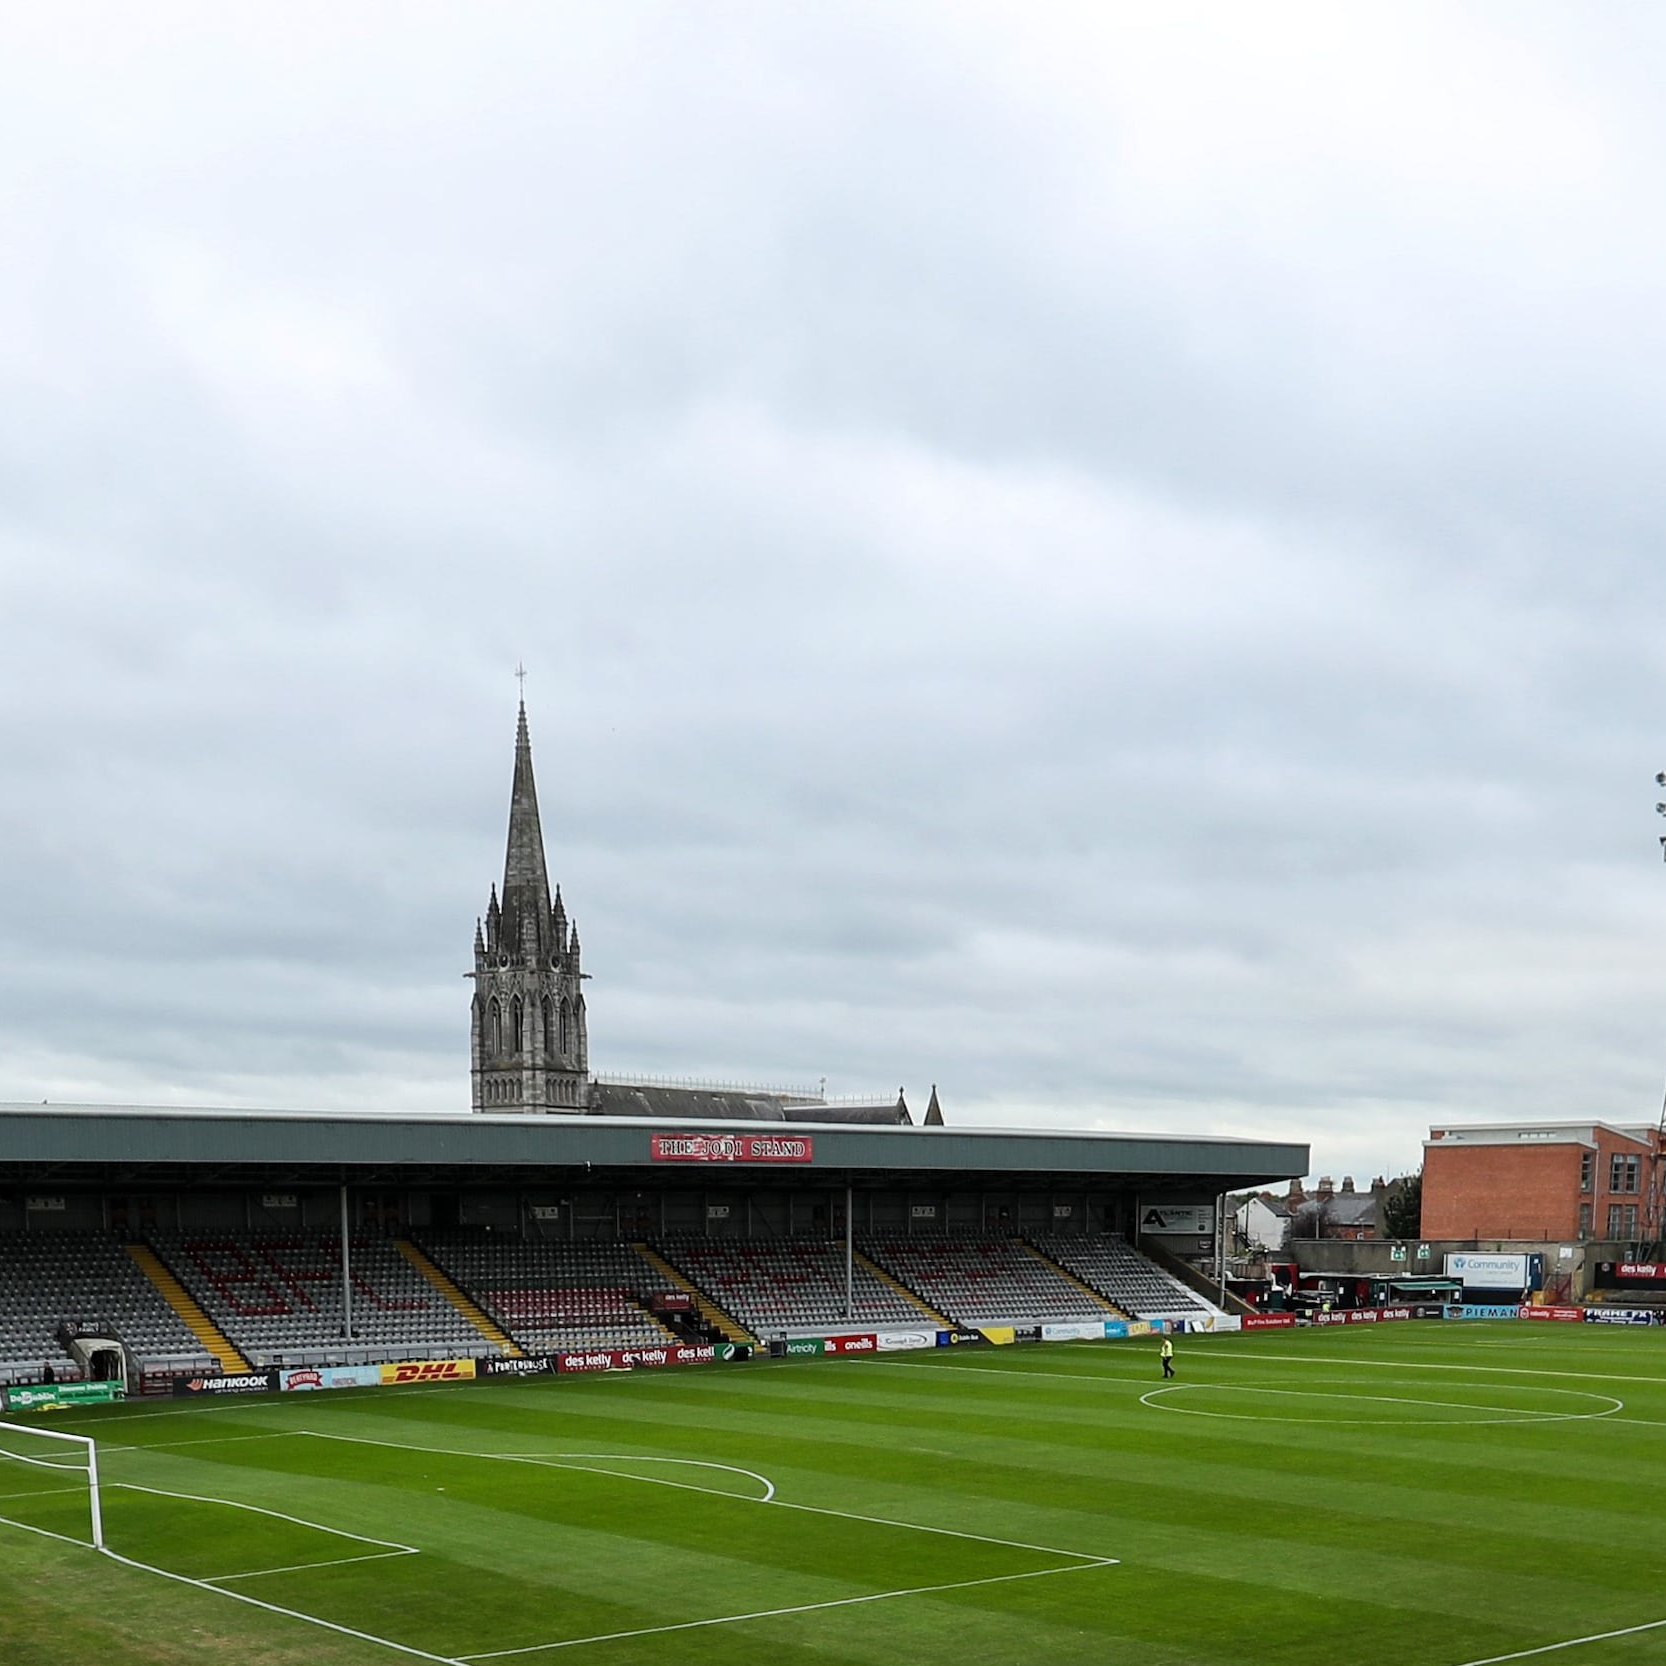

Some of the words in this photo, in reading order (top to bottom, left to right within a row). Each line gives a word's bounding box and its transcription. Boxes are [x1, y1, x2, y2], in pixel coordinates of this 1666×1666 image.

[659, 1139, 693, 1155] THE
[701, 1140, 742, 1156] JODI
[751, 1140, 806, 1157] STAND
[1467, 1259, 1520, 1272] Community
[1620, 1264, 1635, 1273] des
[1636, 1264, 1657, 1277] kelly
[1318, 1313, 1330, 1322] des
[1331, 1312, 1346, 1324] kelly
[1351, 1312, 1362, 1321] des
[1363, 1311, 1377, 1322] kelly
[1383, 1310, 1394, 1318] des
[1395, 1309, 1410, 1319] kelly
[1465, 1307, 1517, 1318] PIEMAN
[1586, 1308, 1628, 1317] FRAME
[1632, 1308, 1648, 1318] FX
[786, 1342, 817, 1355] Airtricity
[845, 1338, 873, 1350] oneills
[642, 1350, 667, 1365] kelly
[677, 1347, 695, 1358] des
[565, 1355, 584, 1367] des
[585, 1353, 612, 1368] kelly
[395, 1363, 462, 1382] DHL
